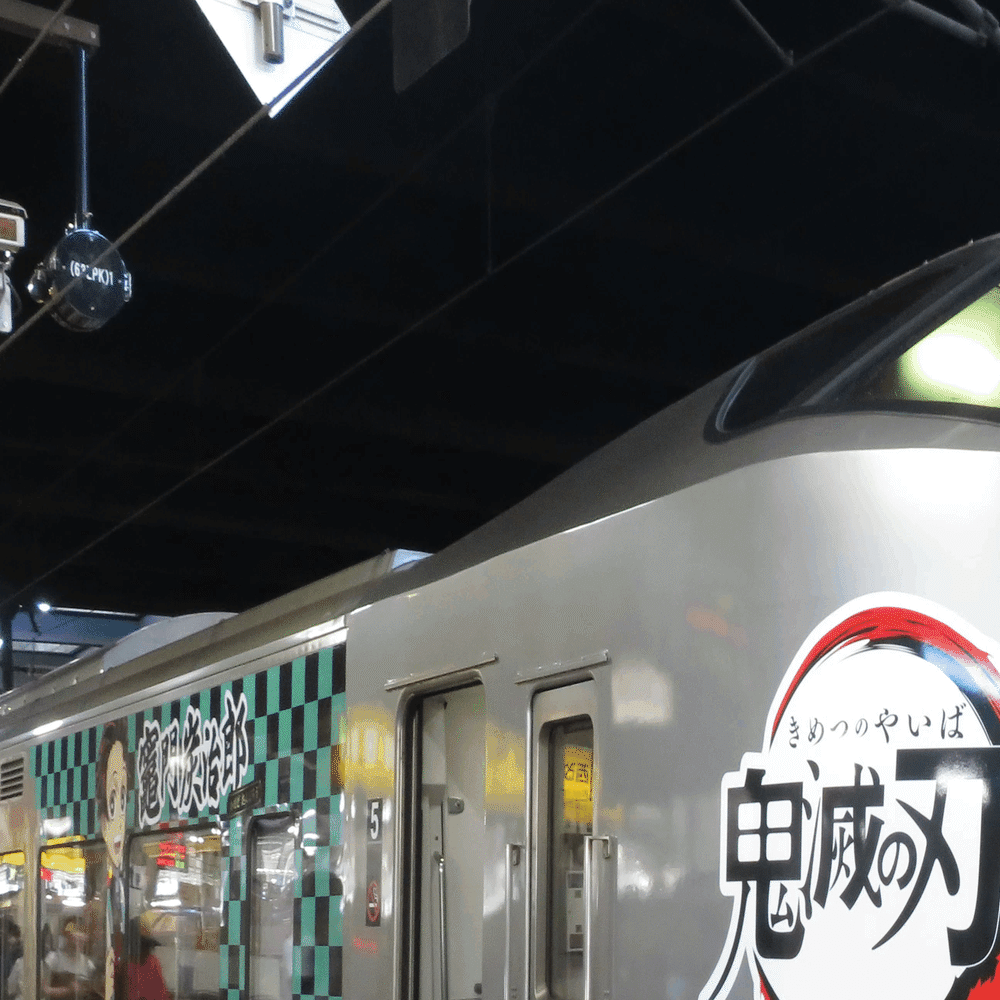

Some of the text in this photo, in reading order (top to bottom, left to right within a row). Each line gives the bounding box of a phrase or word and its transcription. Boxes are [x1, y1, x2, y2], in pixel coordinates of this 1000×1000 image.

[788, 703, 966, 748] きめつのやいば
[370, 801, 379, 840] 5
